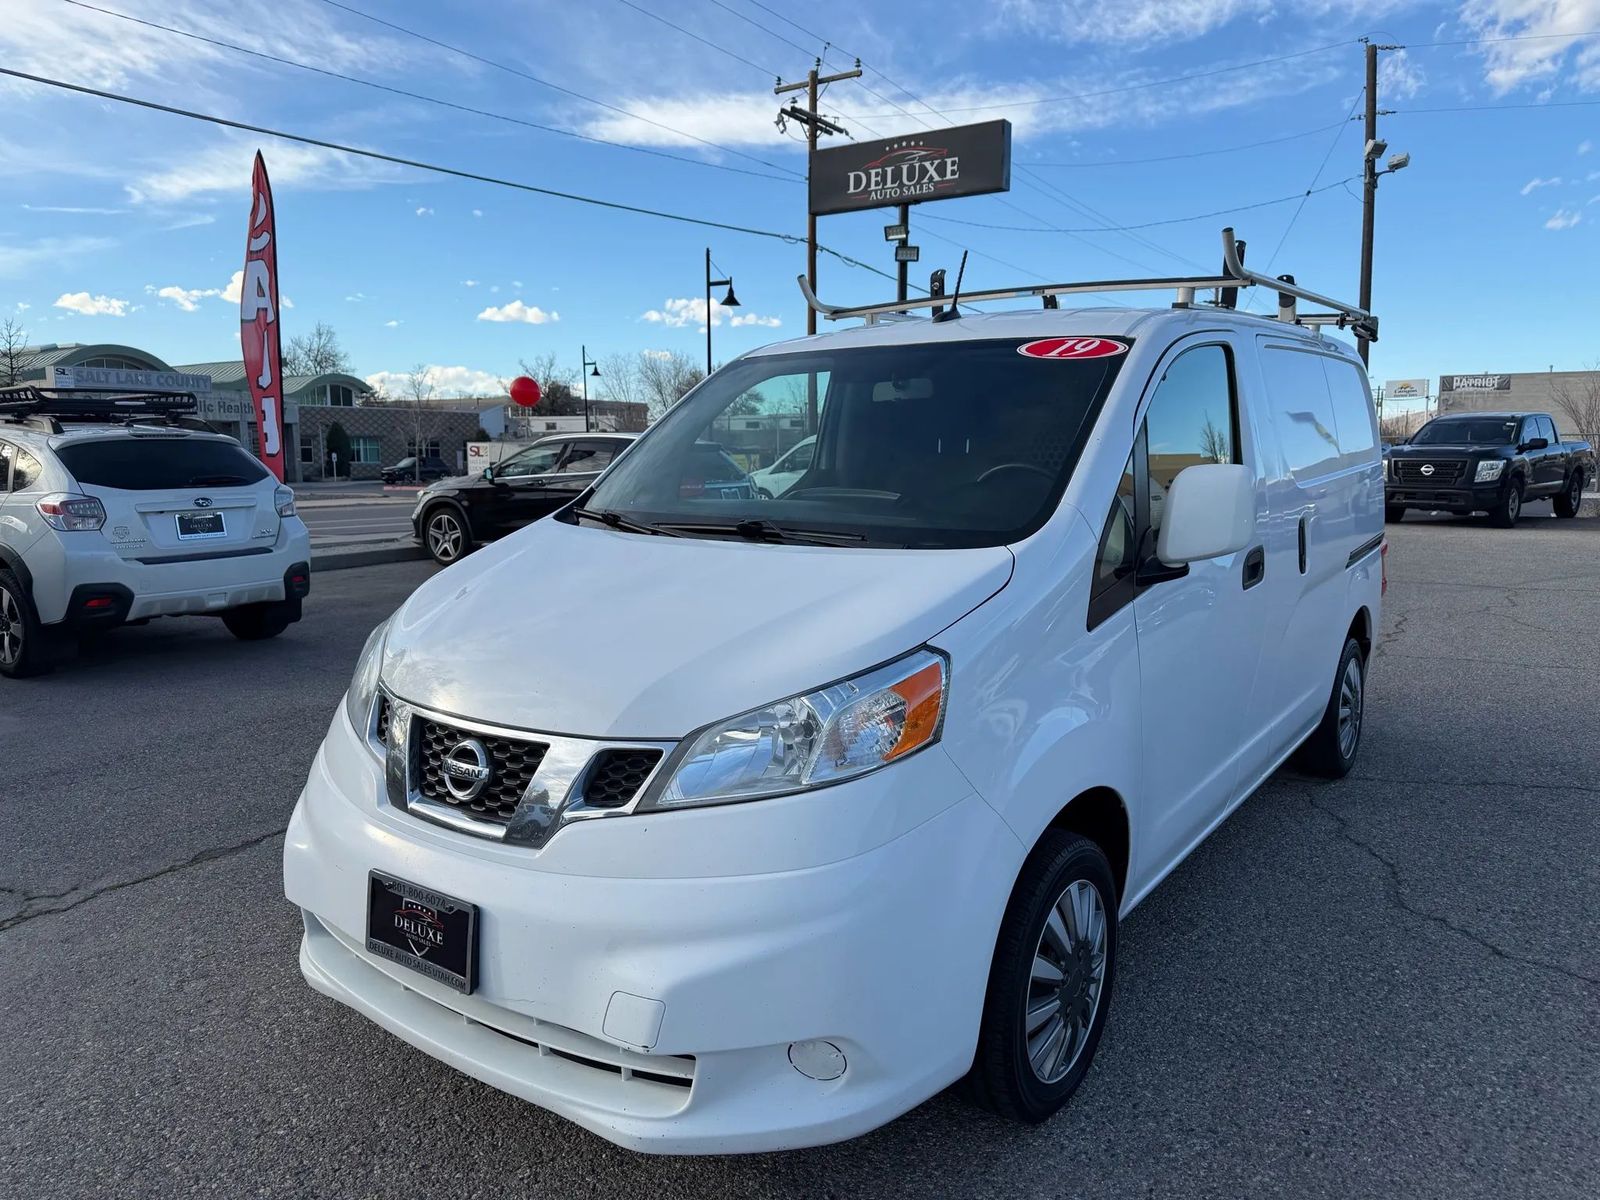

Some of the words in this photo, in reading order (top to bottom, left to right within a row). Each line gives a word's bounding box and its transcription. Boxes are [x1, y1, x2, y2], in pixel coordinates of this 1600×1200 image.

[847, 157, 960, 194] DELUXE
[869, 188, 900, 201] AUTO
[902, 182, 935, 196] SALES
[1042, 339, 1101, 356] 19
[74, 369, 112, 384] SALT
[116, 371, 152, 386] LAKE
[156, 373, 211, 389] COUNTY
[1453, 376, 1500, 390] PATRIOT
[217, 400, 254, 414] Health
[444, 761, 483, 779] NISSAN
[394, 914, 444, 945] DELUXE
